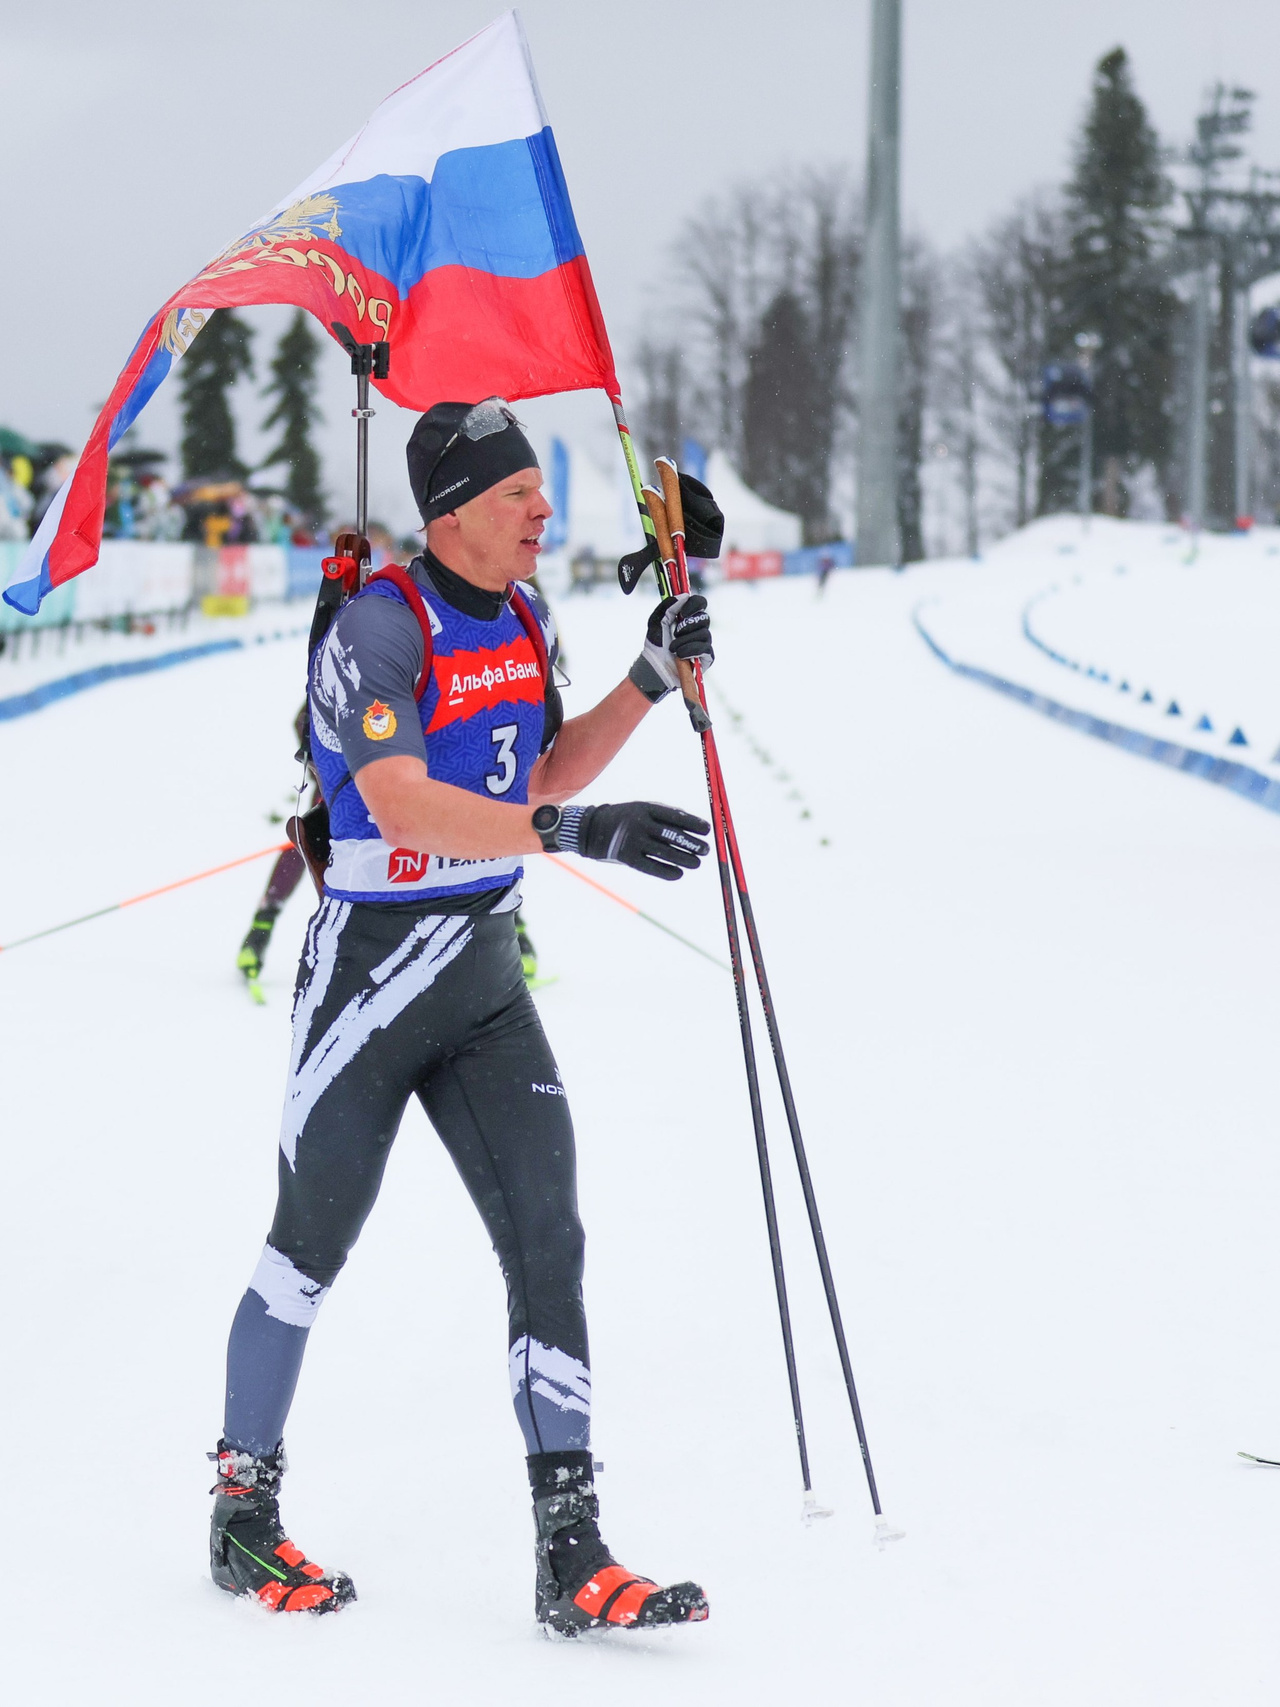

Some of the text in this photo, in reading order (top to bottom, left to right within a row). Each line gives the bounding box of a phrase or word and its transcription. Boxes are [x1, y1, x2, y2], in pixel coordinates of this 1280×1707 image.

[435, 476, 470, 500] NORDSKI
[449, 659, 541, 696] Альфа Банк
[486, 724, 518, 796] 3
